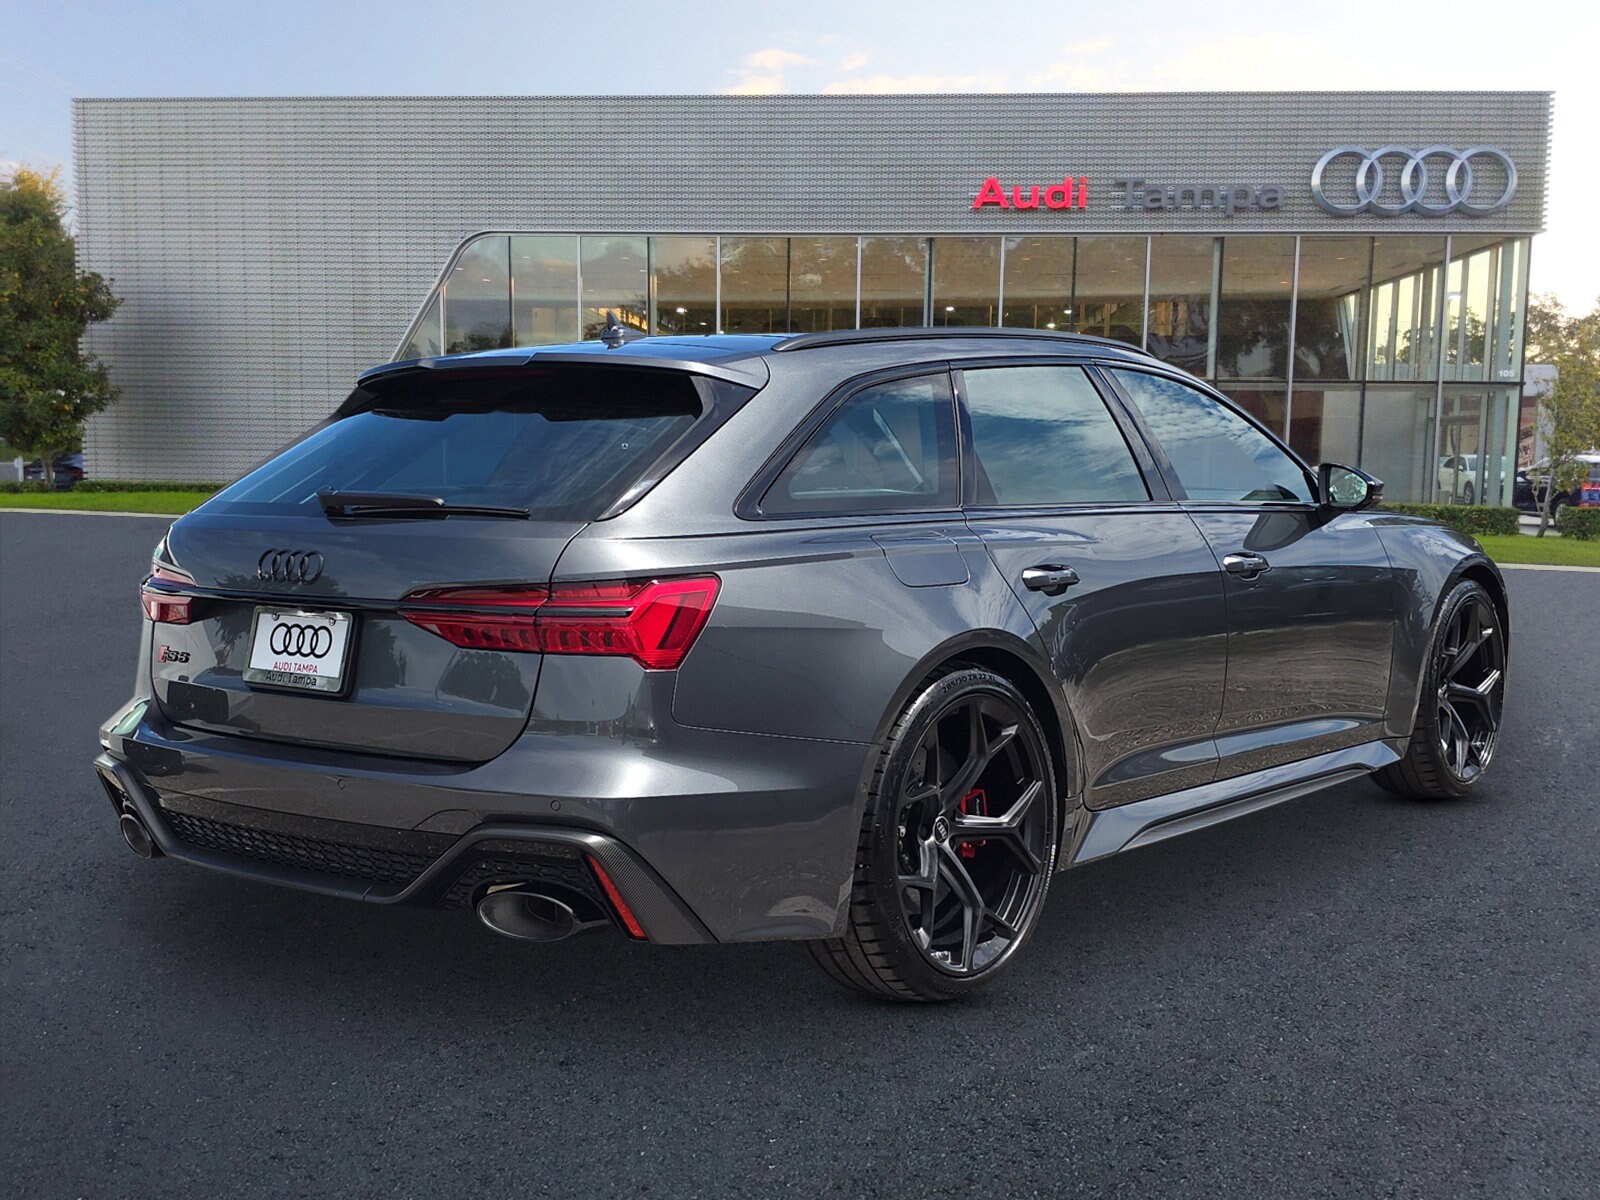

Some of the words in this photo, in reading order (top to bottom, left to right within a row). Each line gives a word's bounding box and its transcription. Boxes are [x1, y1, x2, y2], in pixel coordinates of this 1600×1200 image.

[972, 176, 1088, 209] Audi
[1112, 177, 1285, 217] Tampa
[1499, 369, 1515, 377] 105
[273, 661, 292, 671] AUDI
[293, 663, 318, 674] TAMPA
[265, 670, 286, 682] Audi
[287, 673, 318, 687] Tampa
